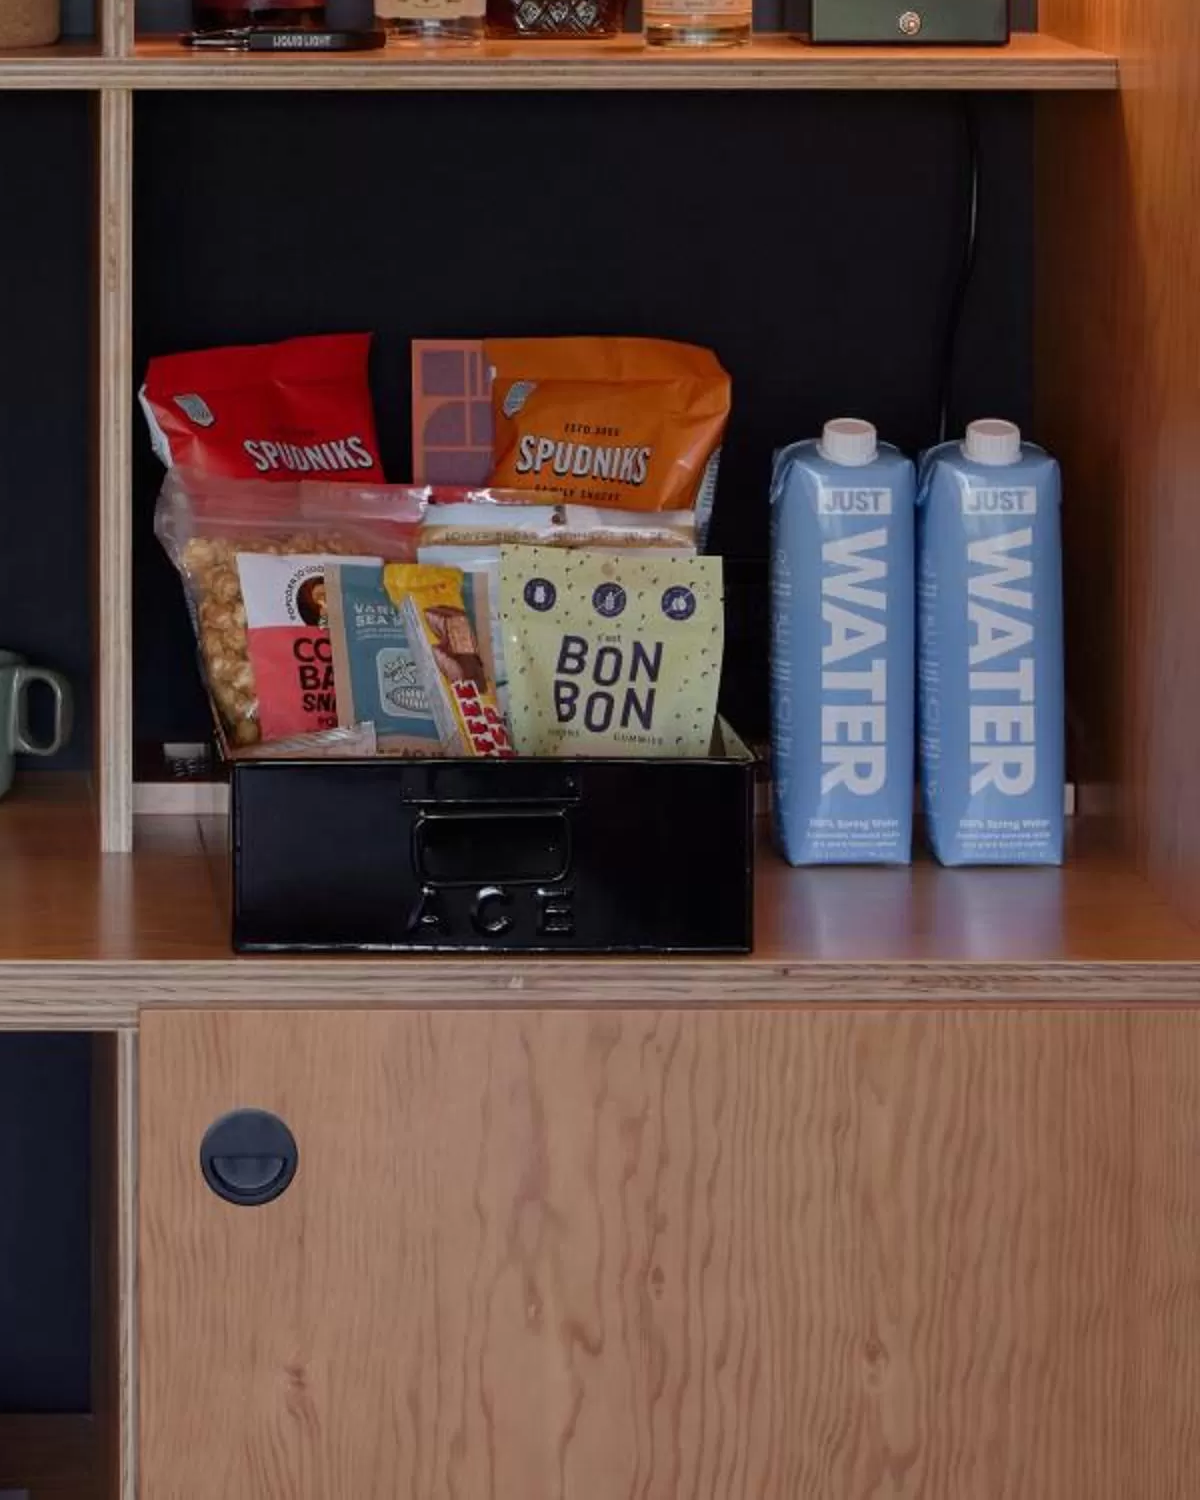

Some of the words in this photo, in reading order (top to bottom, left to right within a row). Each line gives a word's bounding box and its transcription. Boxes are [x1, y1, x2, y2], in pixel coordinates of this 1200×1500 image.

[273, 35, 302, 48] LIQUID
[303, 35, 332, 48] LIGHT
[243, 435, 374, 472] SPUDNIKS
[516, 434, 651, 485] SPUDNIKS
[824, 490, 883, 513] JUST
[968, 490, 1028, 513] JUST
[293, 637, 333, 663] CO
[556, 634, 664, 687] BON
[821, 525, 888, 796] WATER
[967, 526, 1036, 797] WATER
[299, 665, 336, 690] BA
[452, 680, 497, 758] FFEE
[554, 679, 656, 733] BON
[406, 886, 575, 937] ACE
